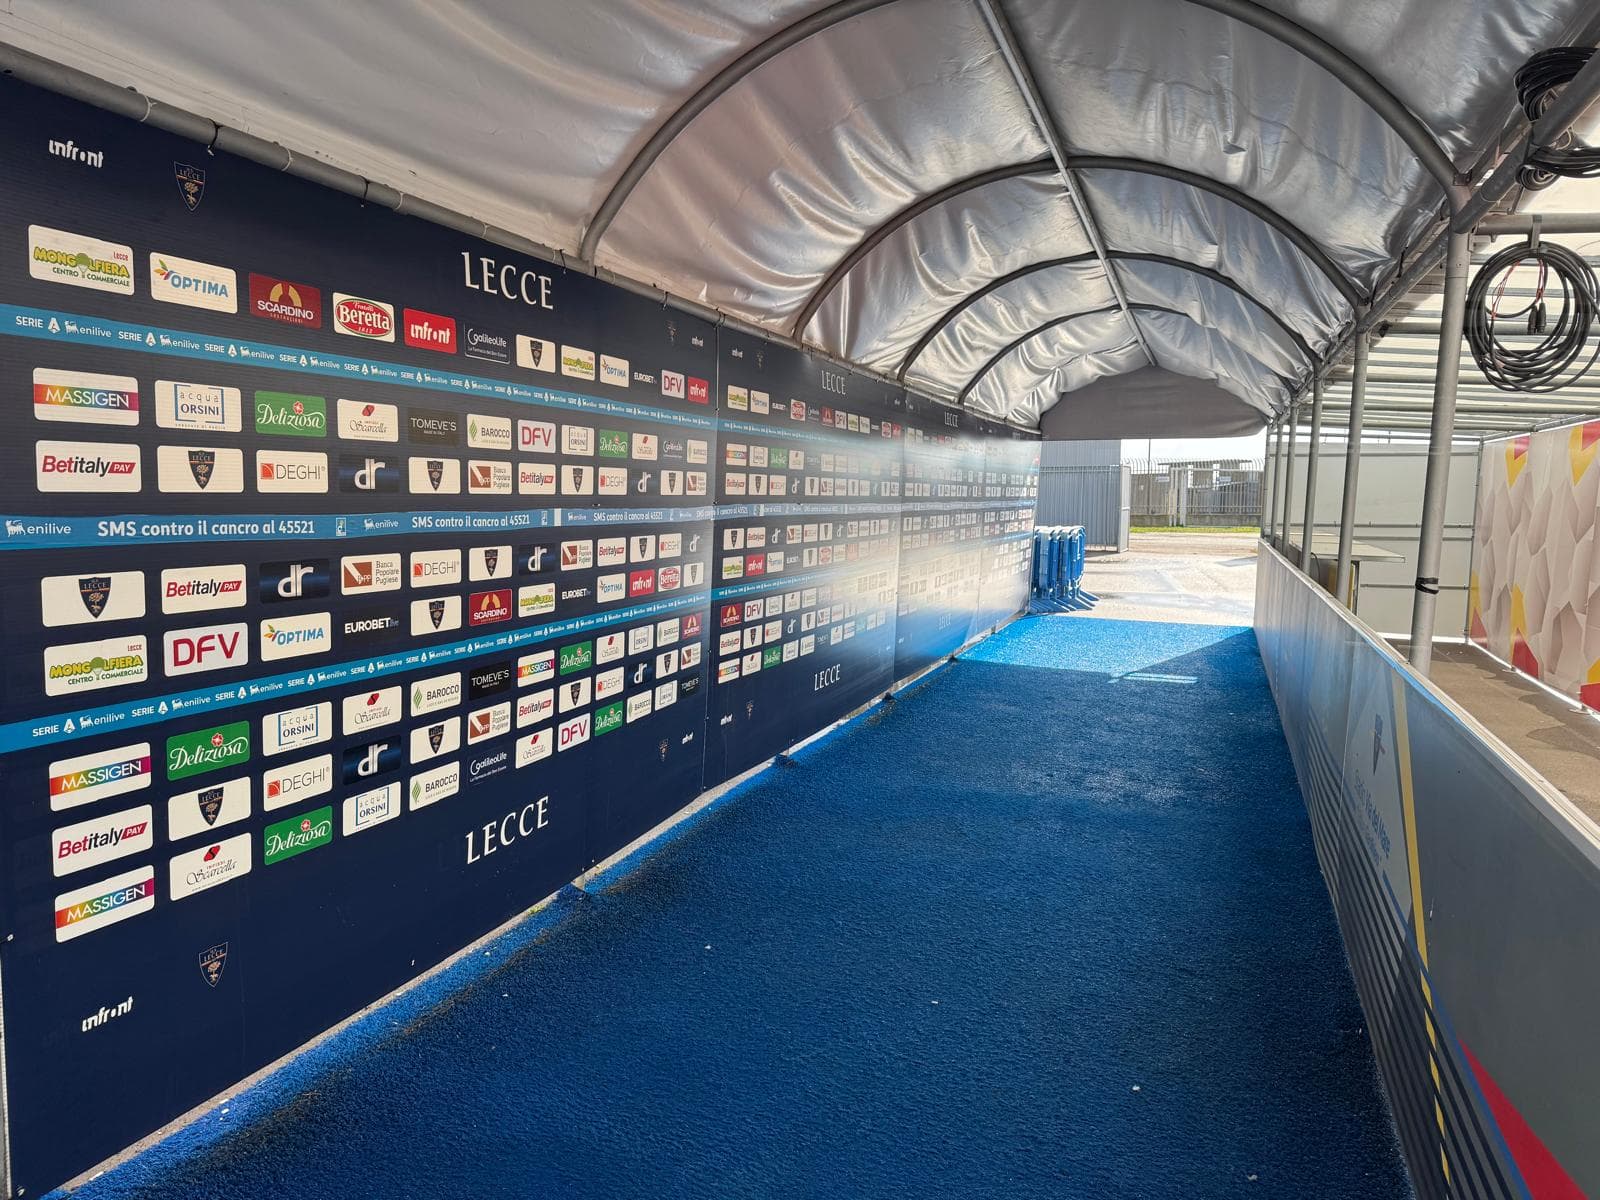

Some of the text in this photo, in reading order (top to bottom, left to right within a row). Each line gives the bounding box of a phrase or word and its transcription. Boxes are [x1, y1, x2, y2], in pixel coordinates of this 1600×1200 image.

[52, 267, 130, 287] CENTRO COMMERCIALE
[171, 274, 229, 298] OPTIMA
[461, 252, 554, 310] LECCE
[257, 300, 314, 320] SCARDINO
[339, 304, 391, 330] Beretta
[15, 315, 44, 329] SERIE
[79, 326, 112, 338] enilive
[118, 331, 142, 342] SERIE
[172, 339, 200, 350] enilive
[204, 344, 225, 353] SERIE
[251, 351, 274, 360] enilive
[279, 354, 297, 363] SERIE
[319, 360, 340, 369] enilive
[344, 363, 359, 372] SERIE
[379, 368, 397, 377] enilive
[401, 372, 415, 380] SERIE
[664, 375, 682, 392] DFV
[822, 370, 846, 395] LECCE
[45, 387, 129, 408] MASSIGEN
[179, 391, 219, 403] acqua
[180, 404, 219, 416] ORSINI
[257, 403, 326, 431] Deliziosa
[410, 417, 457, 432] TOMEVE'S
[481, 428, 510, 438] BAROCCO
[522, 426, 552, 446] DFV
[42, 455, 131, 477] Betitaly PAY
[276, 464, 321, 480] DEGHI
[354, 458, 386, 490] dr
[27, 523, 72, 535] enilive
[98, 521, 137, 537] SMS
[141, 523, 193, 536] contro
[198, 520, 207, 535] il
[212, 521, 259, 535] cancro
[263, 520, 275, 534] al
[279, 521, 315, 534] 45521
[375, 520, 399, 528] enilive
[412, 516, 433, 528] SMS
[435, 518, 462, 527] contro
[466, 516, 470, 526] il
[473, 518, 497, 526] cancro
[500, 516, 508, 526] al
[509, 514, 530, 525] 45521
[594, 513, 605, 521] SMS
[376, 561, 393, 569] Banca
[528, 546, 547, 571] dr
[277, 564, 314, 597] dr
[376, 567, 400, 576] Popolare
[376, 576, 398, 585] Pugliese
[166, 579, 238, 597] Betitaly PAY
[474, 608, 507, 620] SCARDINO
[277, 627, 324, 645] OPTIMA
[173, 632, 240, 667] DFV
[67, 668, 144, 685] CENTRO COMMERCIALE
[471, 670, 510, 687] TOMEVE'S
[522, 661, 551, 677] MASSIGEN
[814, 664, 840, 691] LECCE
[32, 724, 59, 737] SERIE
[94, 712, 125, 726] enilive
[131, 706, 155, 718] SERIE
[184, 696, 211, 708] enilive
[215, 691, 235, 701] SERIE
[260, 682, 283, 693] enilive
[287, 677, 305, 687] SERIE
[326, 669, 347, 679] enilive
[350, 666, 366, 675] SERIE
[384, 659, 402, 668] enilive
[406, 655, 419, 664] SERIE
[426, 684, 459, 701] BAROCCO
[283, 723, 314, 738] ORSINI
[561, 720, 587, 745] DFV
[169, 737, 249, 771] Deliziosa
[358, 744, 388, 777] dr
[61, 761, 142, 791] MASSIGEN
[282, 768, 325, 794] DEGHI
[425, 773, 458, 793] BAROCCO
[359, 803, 386, 818] ORSINI
[266, 820, 332, 857] Deliziosa
[466, 795, 549, 864] LECCE
[58, 825, 142, 859] Betitaly PAY
[66, 884, 146, 923] MASSIGEN
